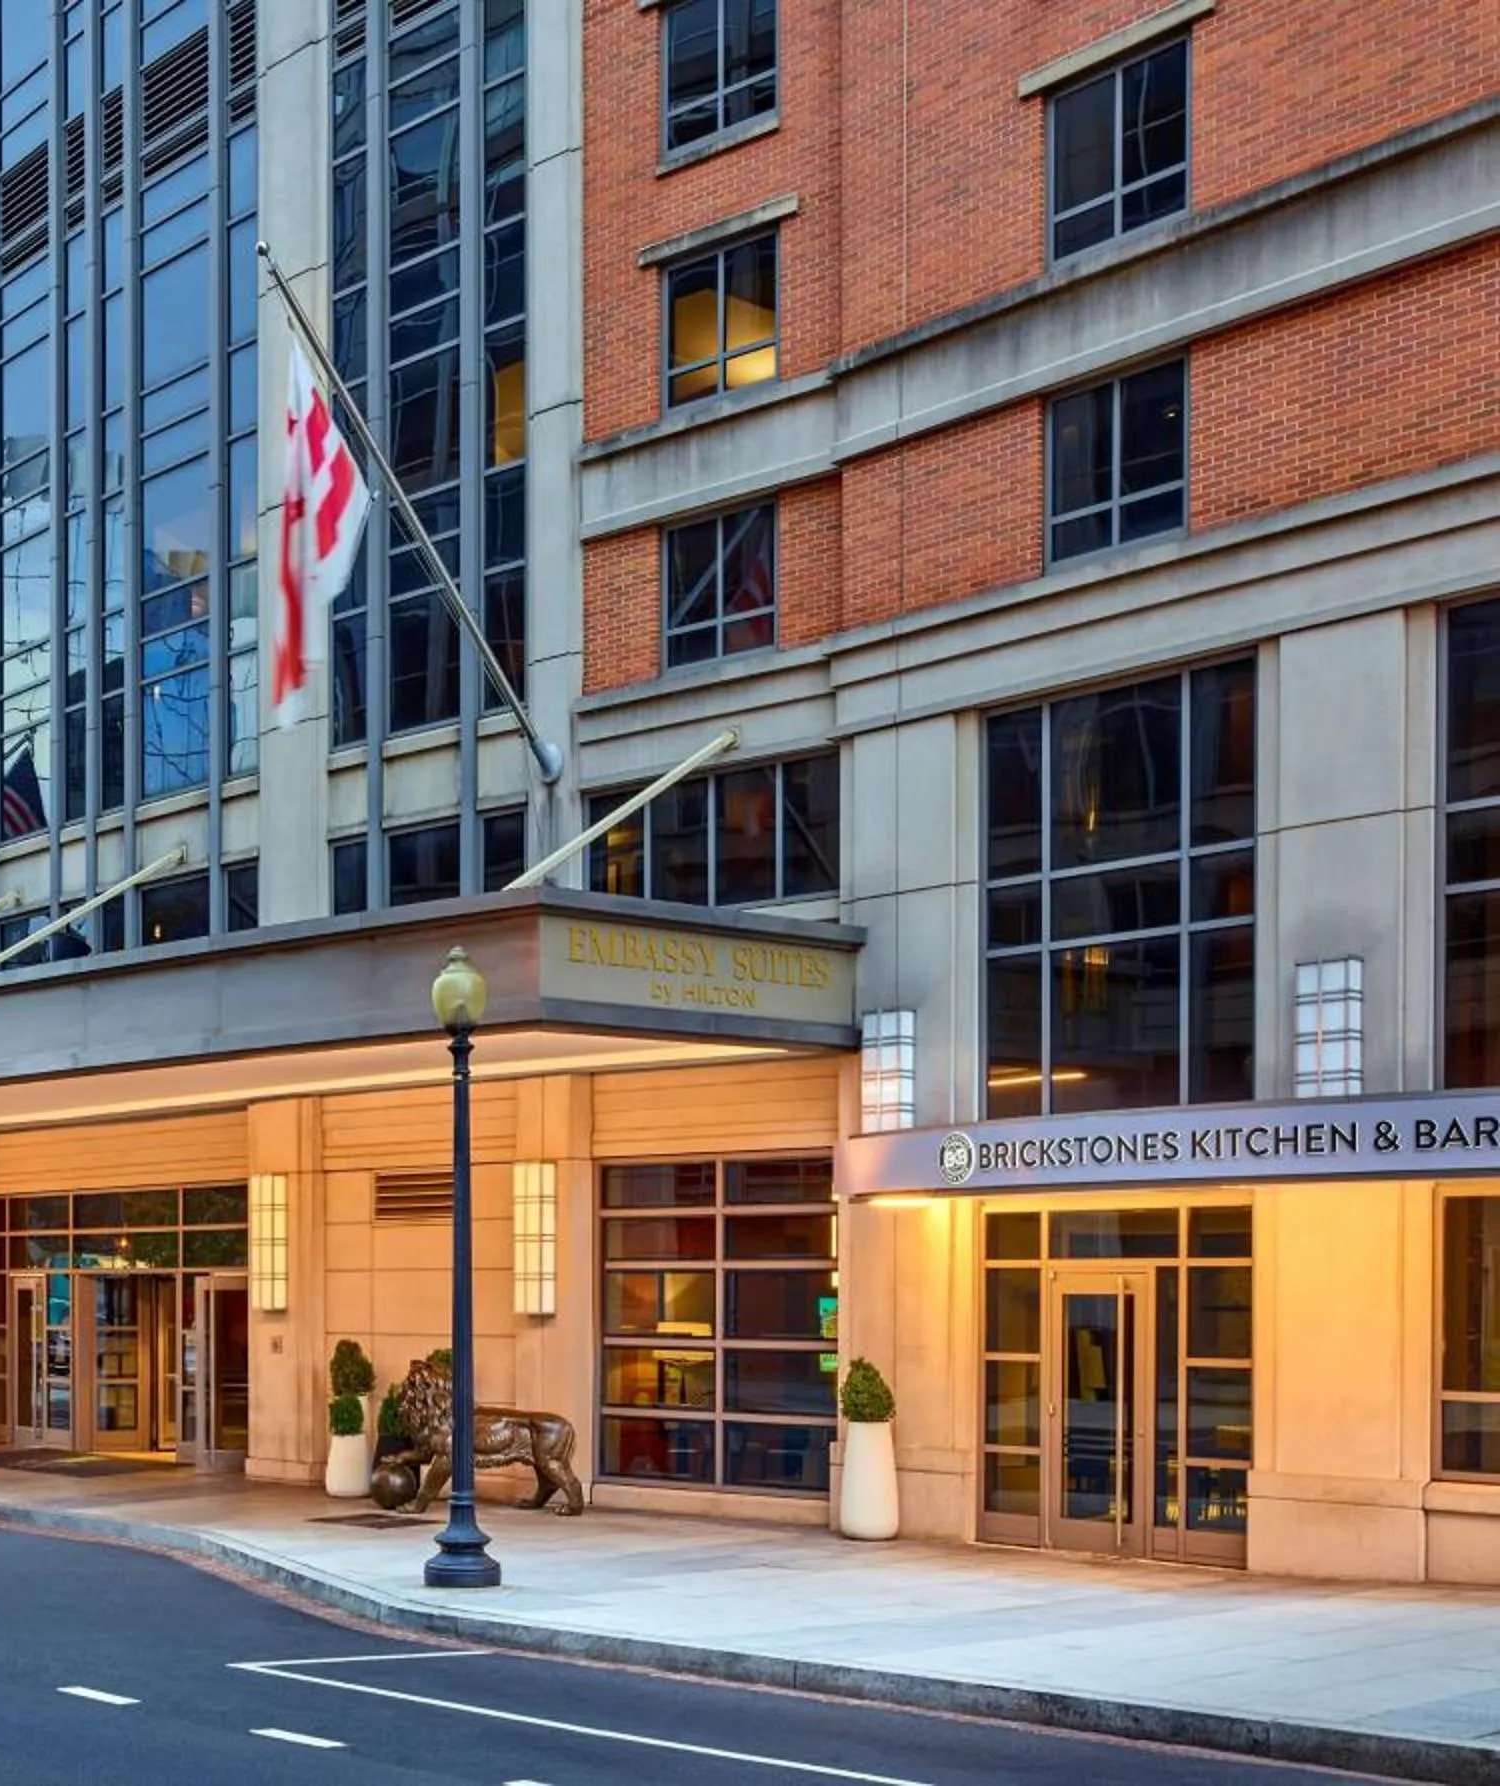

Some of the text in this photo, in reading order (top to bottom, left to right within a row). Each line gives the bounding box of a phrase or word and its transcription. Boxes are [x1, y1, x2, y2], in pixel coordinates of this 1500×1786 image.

[567, 925, 832, 989] EMBASSY SUITES
[682, 983, 756, 1009] HILTON
[979, 1130, 1180, 1170] BRICKSTONES
[1191, 1121, 1358, 1159] KITCHEN
[1373, 1119, 1402, 1151] &
[1415, 1115, 1498, 1149] BAR
